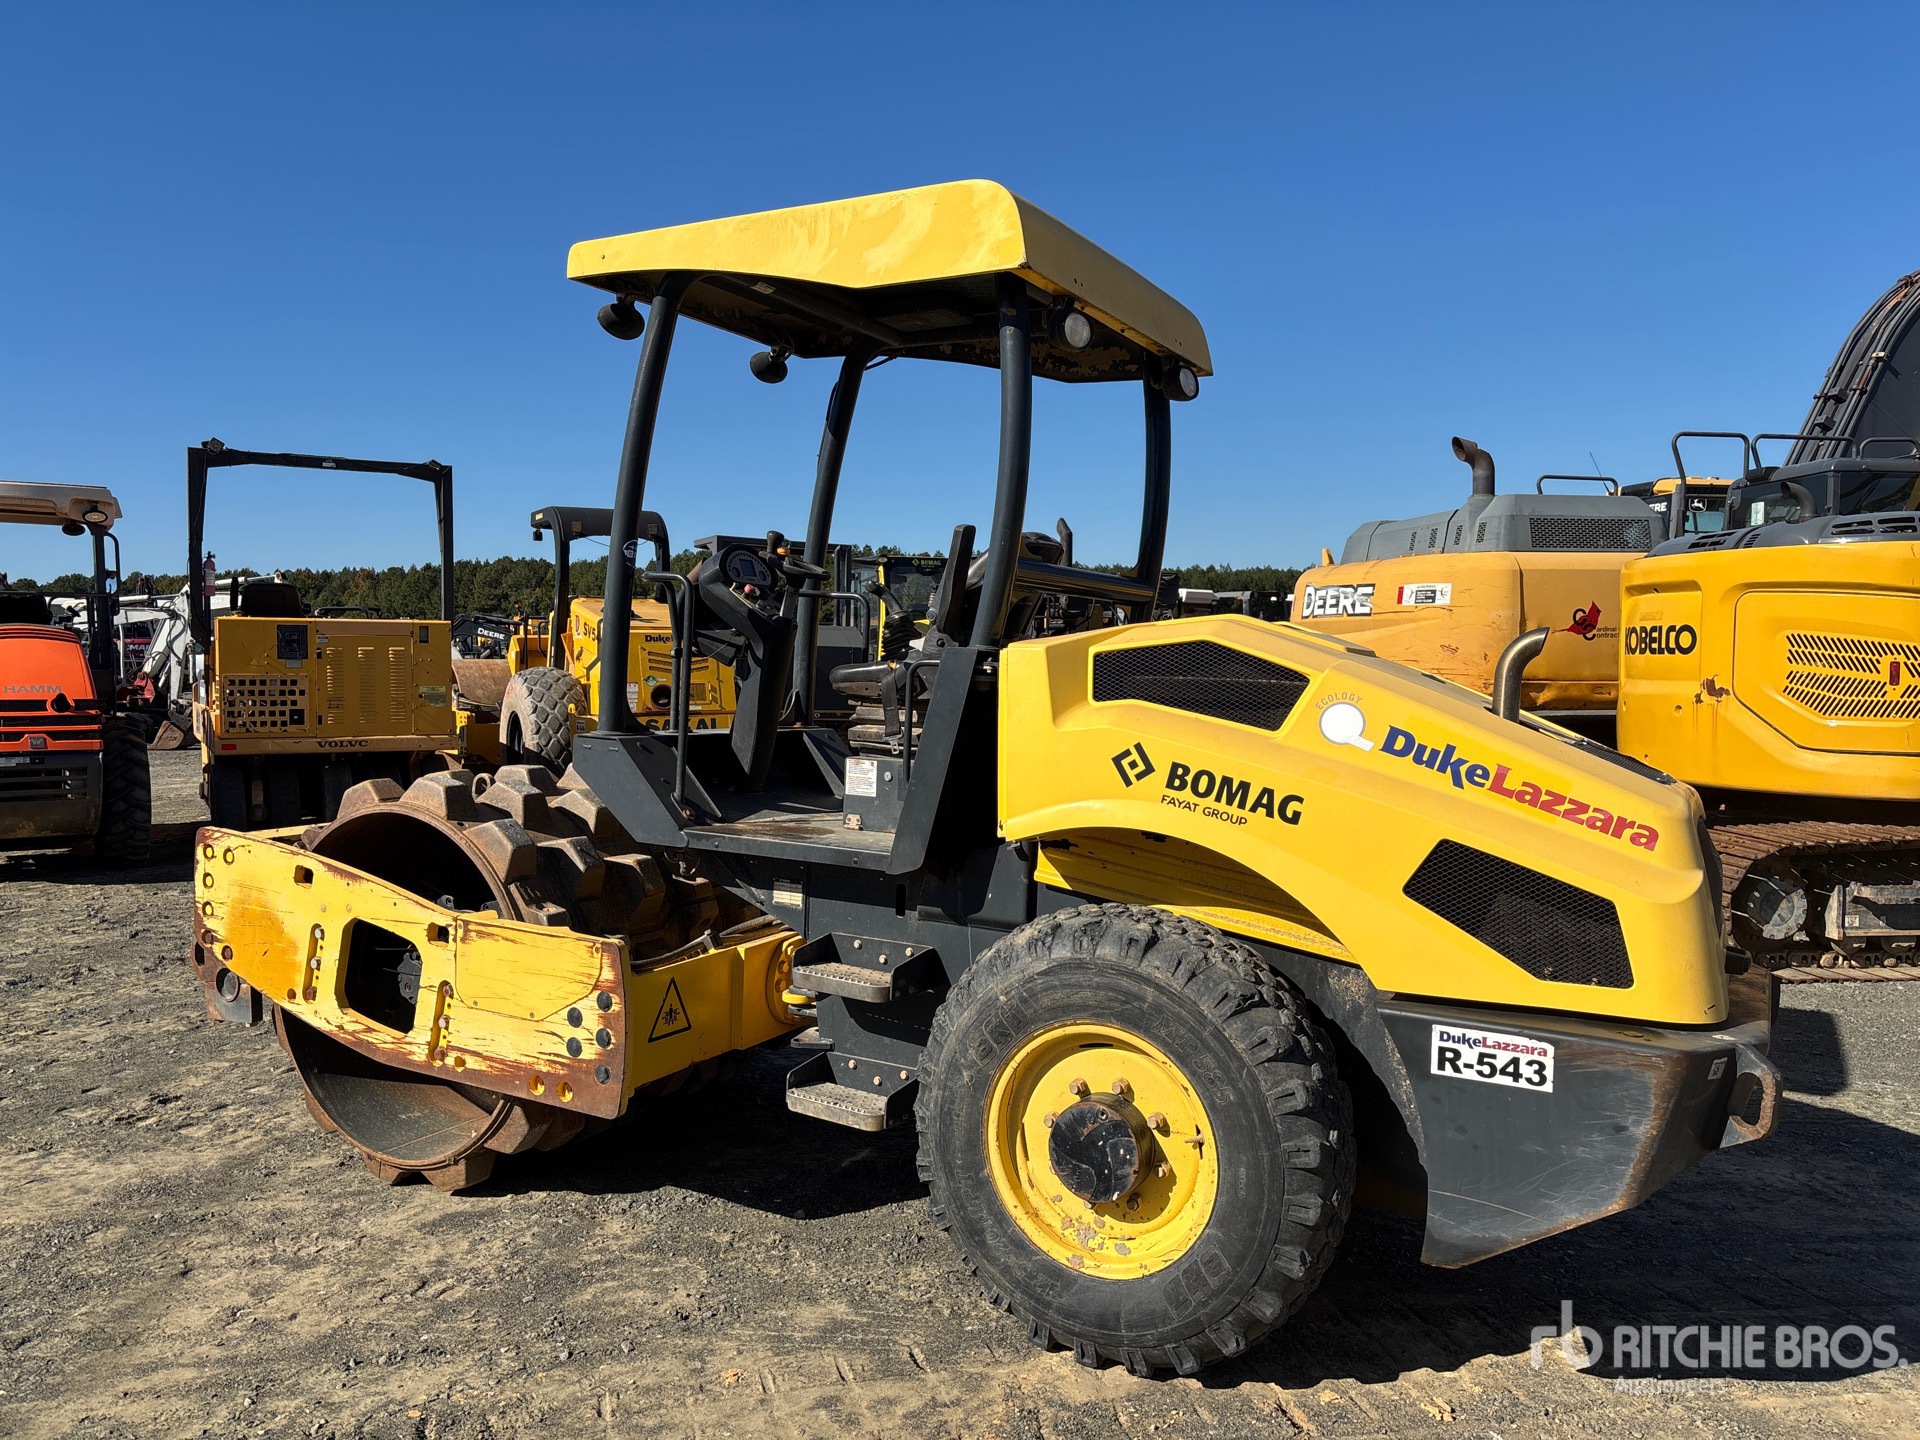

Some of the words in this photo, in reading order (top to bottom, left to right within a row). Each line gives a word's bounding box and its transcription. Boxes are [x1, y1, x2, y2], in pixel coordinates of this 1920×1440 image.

[1301, 583, 1376, 619] DEERE
[477, 627, 505, 640] DEERE
[583, 621, 597, 642] SV5
[1625, 624, 1697, 655] KOBELCO
[3, 685, 62, 694] HAMM
[1315, 692, 1363, 710] ECOLOGY
[1165, 761, 1304, 826] BOMAG
[1378, 725, 1660, 852] DukeLazzara
[1161, 795, 1200, 813] FAYAT
[1202, 806, 1248, 826] GROUP
[1439, 1030, 1548, 1058] DukeLazzara
[1437, 1045, 1548, 1087] R-543
